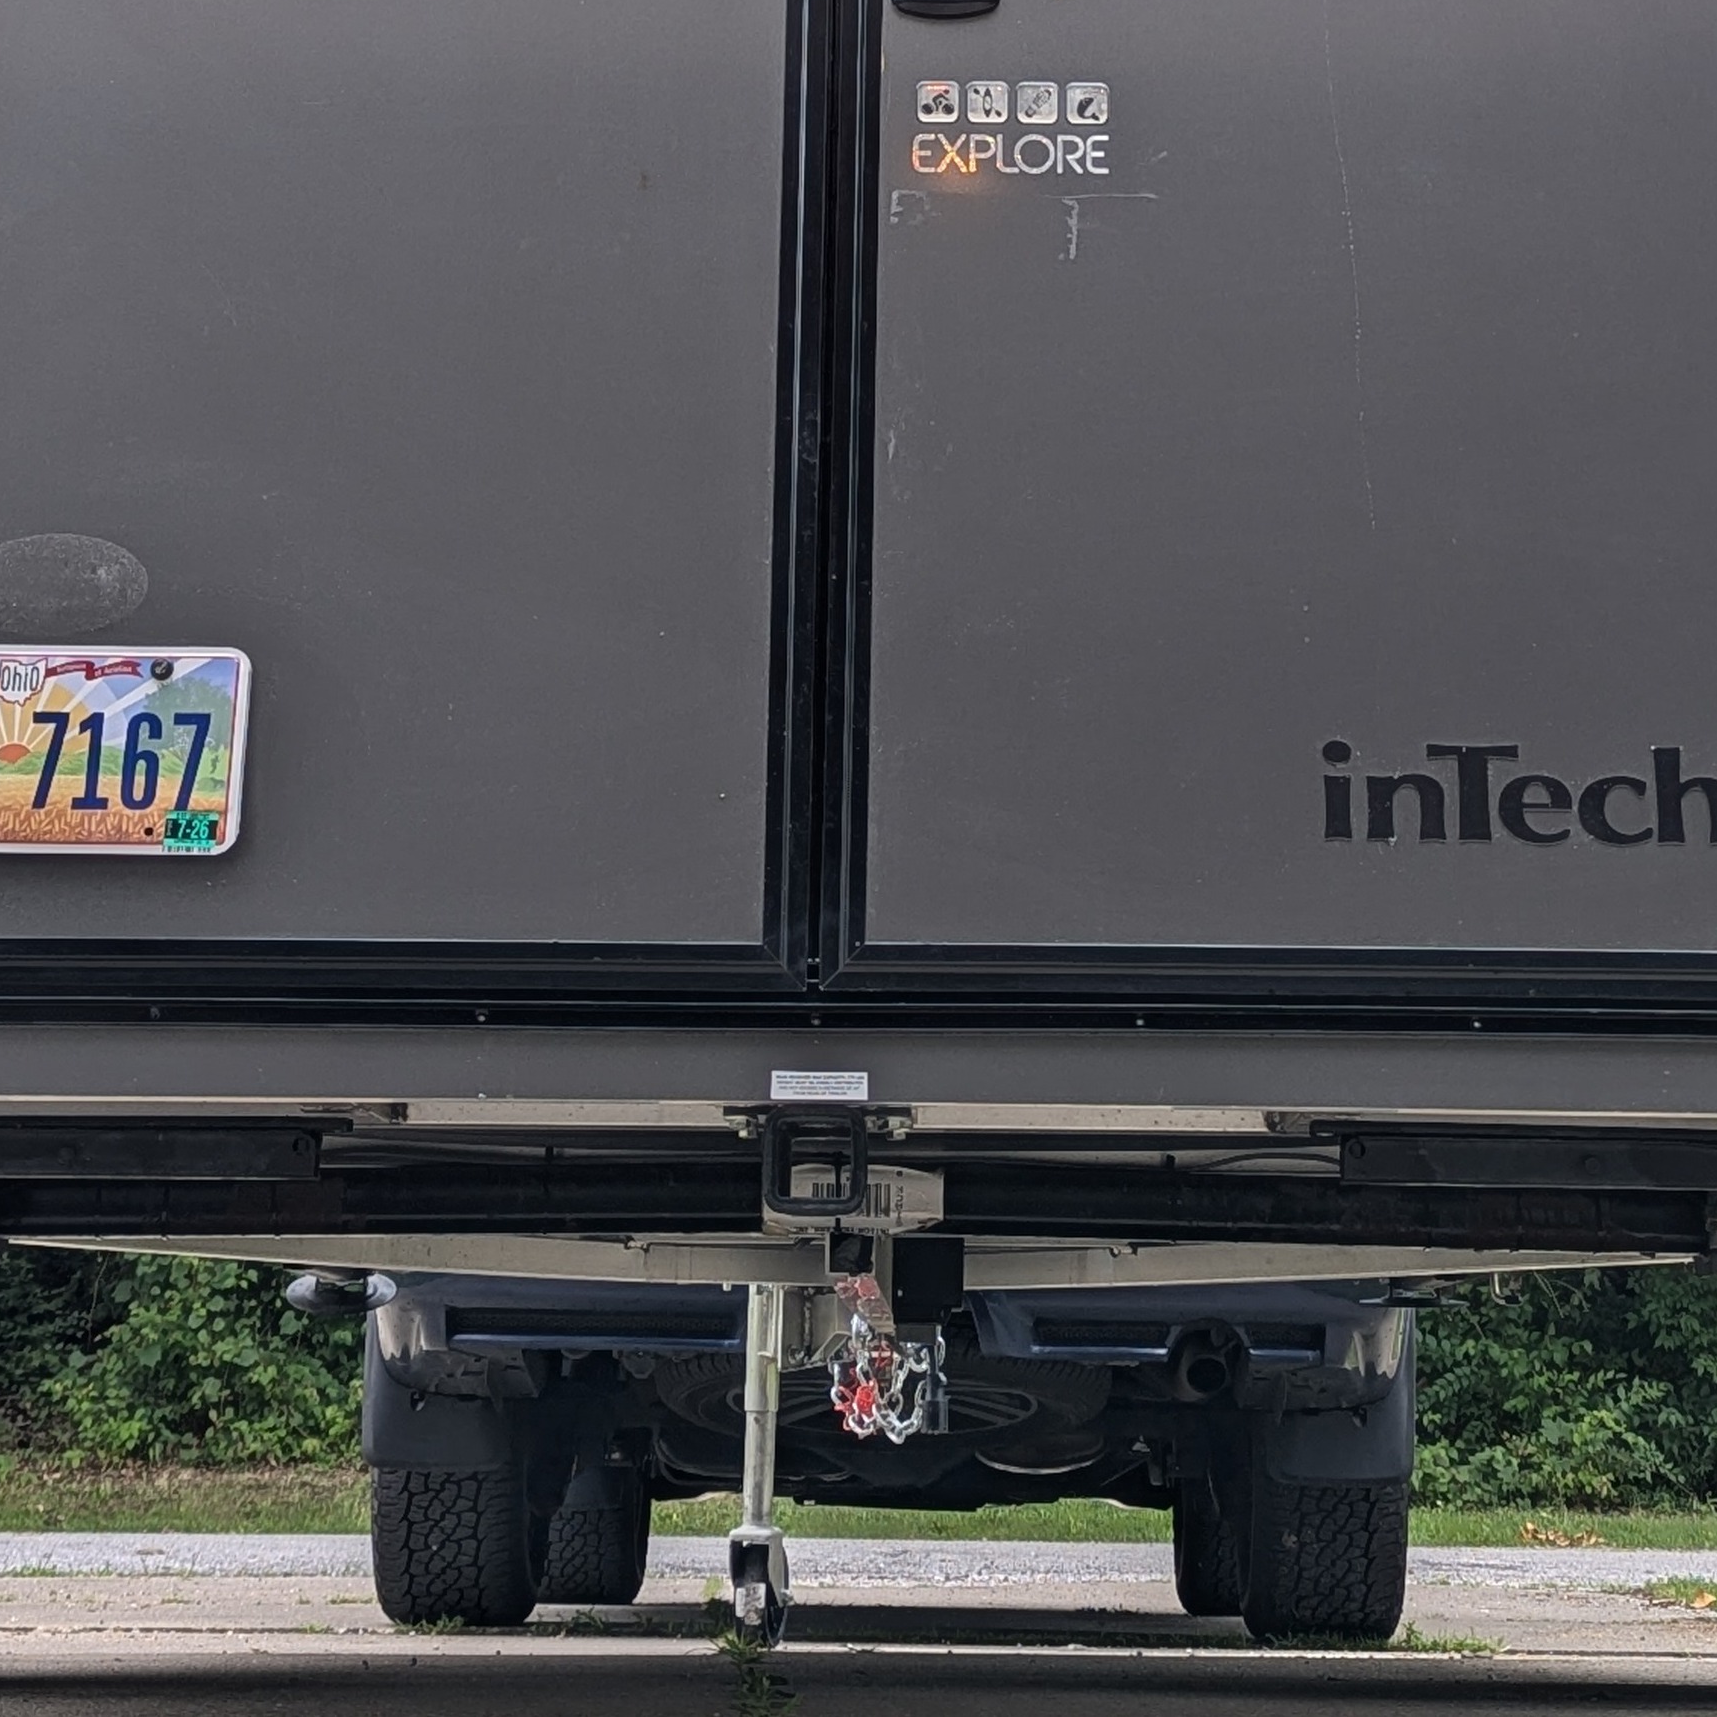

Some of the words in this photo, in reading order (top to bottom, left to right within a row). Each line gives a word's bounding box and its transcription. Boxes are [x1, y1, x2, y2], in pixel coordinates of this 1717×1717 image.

[911, 133, 1110, 175] EXPLORE
[31, 711, 212, 811] 7167
[178, 819, 210, 839] 7-26
